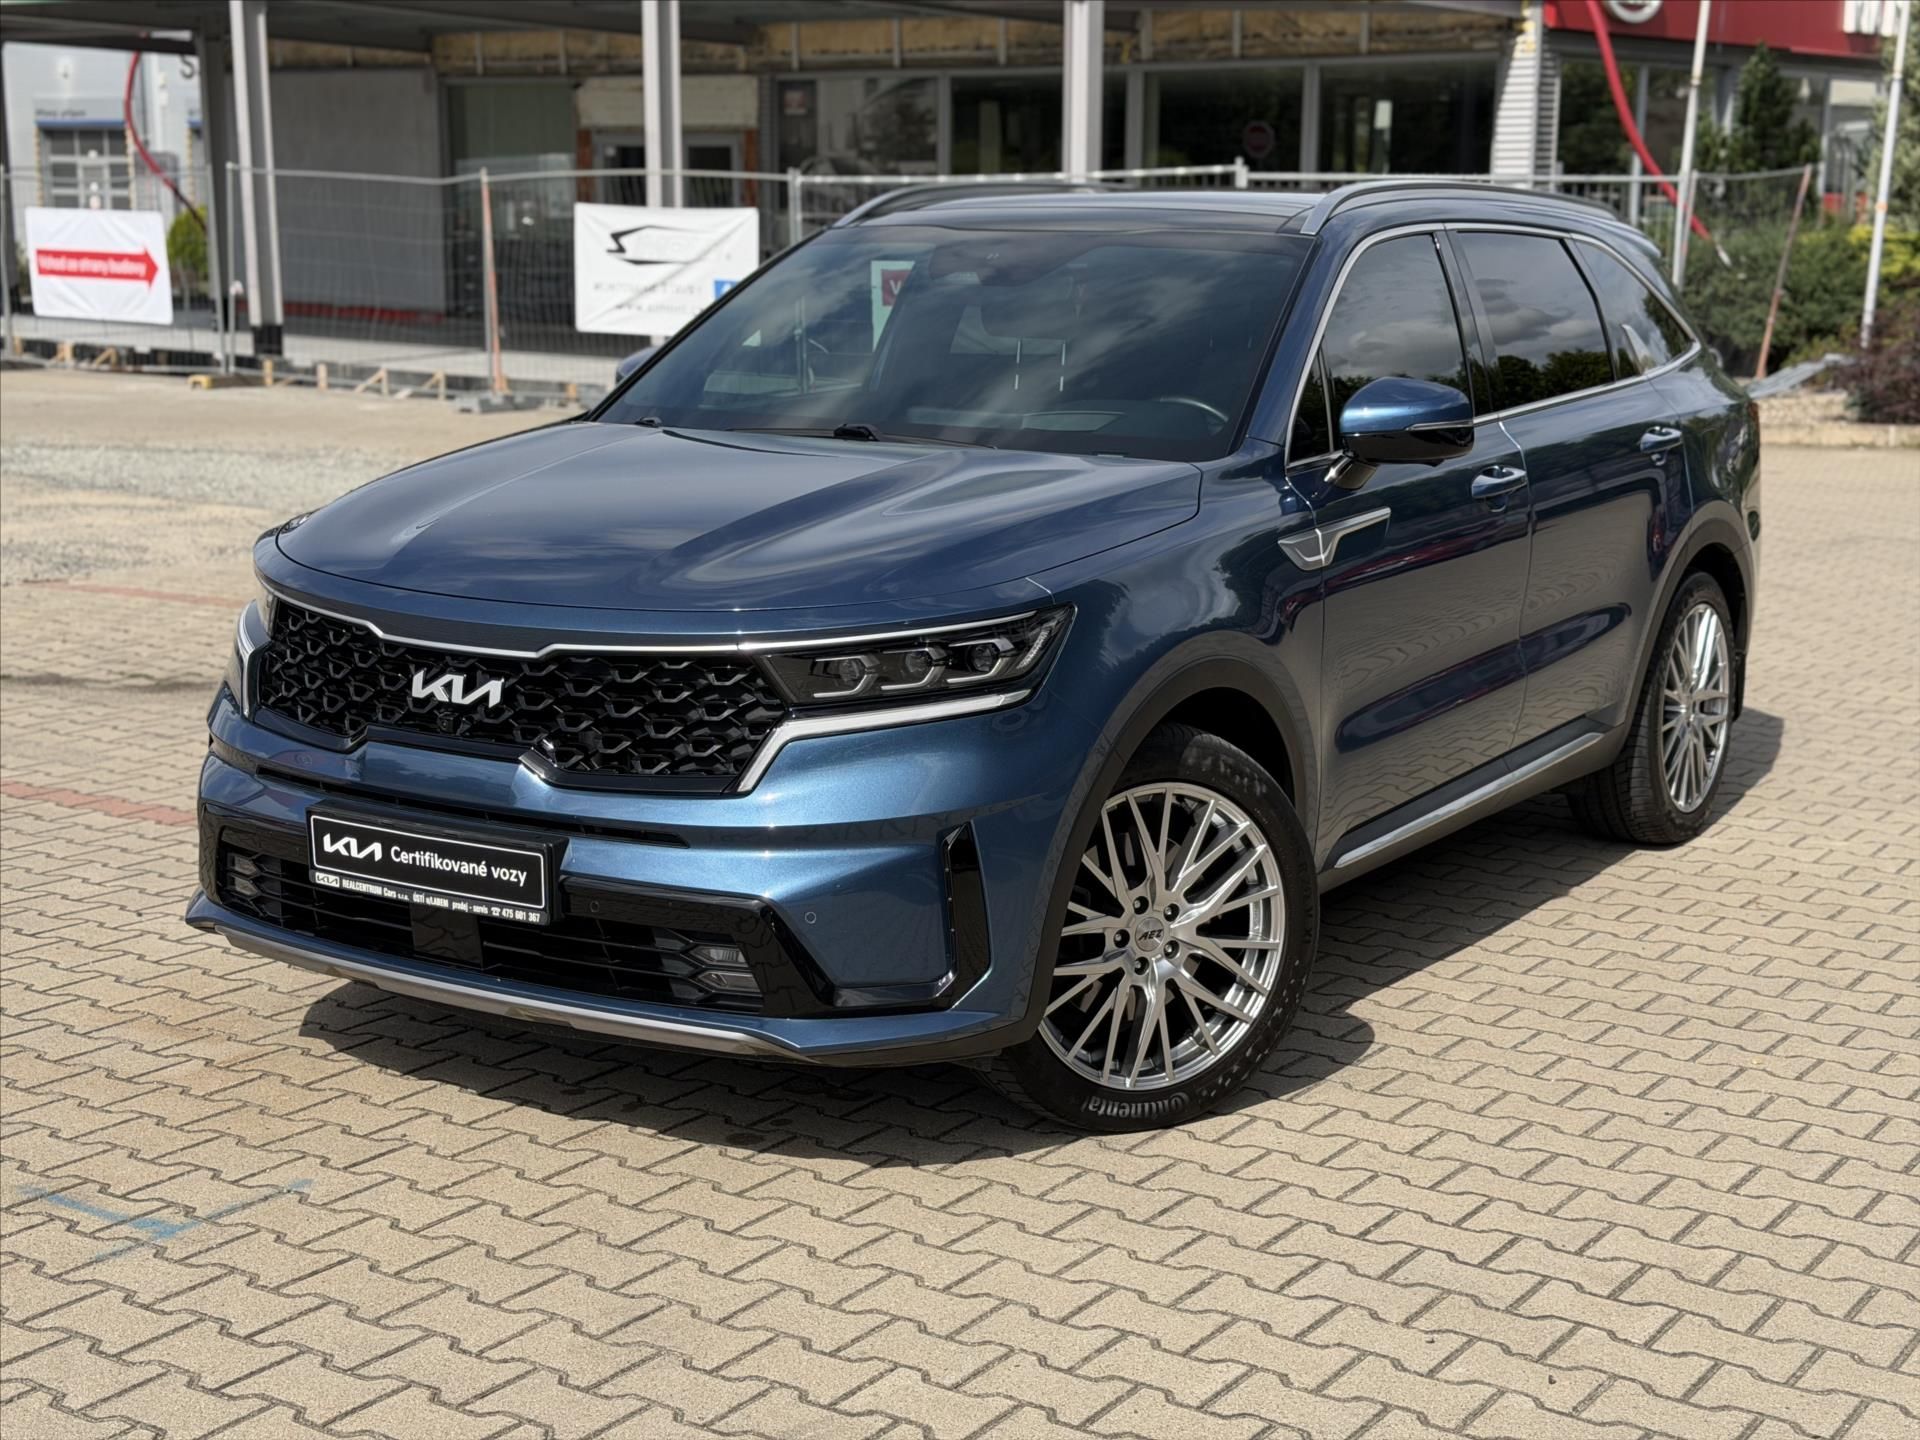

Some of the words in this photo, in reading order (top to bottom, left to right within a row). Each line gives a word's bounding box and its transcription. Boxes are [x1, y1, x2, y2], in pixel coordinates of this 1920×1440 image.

[411, 668, 505, 709] KIA
[323, 833, 383, 862] KIA
[390, 846, 488, 877] Certifikované
[491, 866, 527, 887] vozy
[342, 879, 383, 896] REALCENTRUM
[383, 887, 397, 899] Cars
[452, 901, 469, 913] prodej
[473, 905, 488, 915] servis
[502, 907, 514, 919] 475
[515, 910, 526, 921] 601
[528, 912, 541, 923] 367
[1138, 929, 1164, 941] AEZ
[1080, 1091, 1191, 1120] Continental
